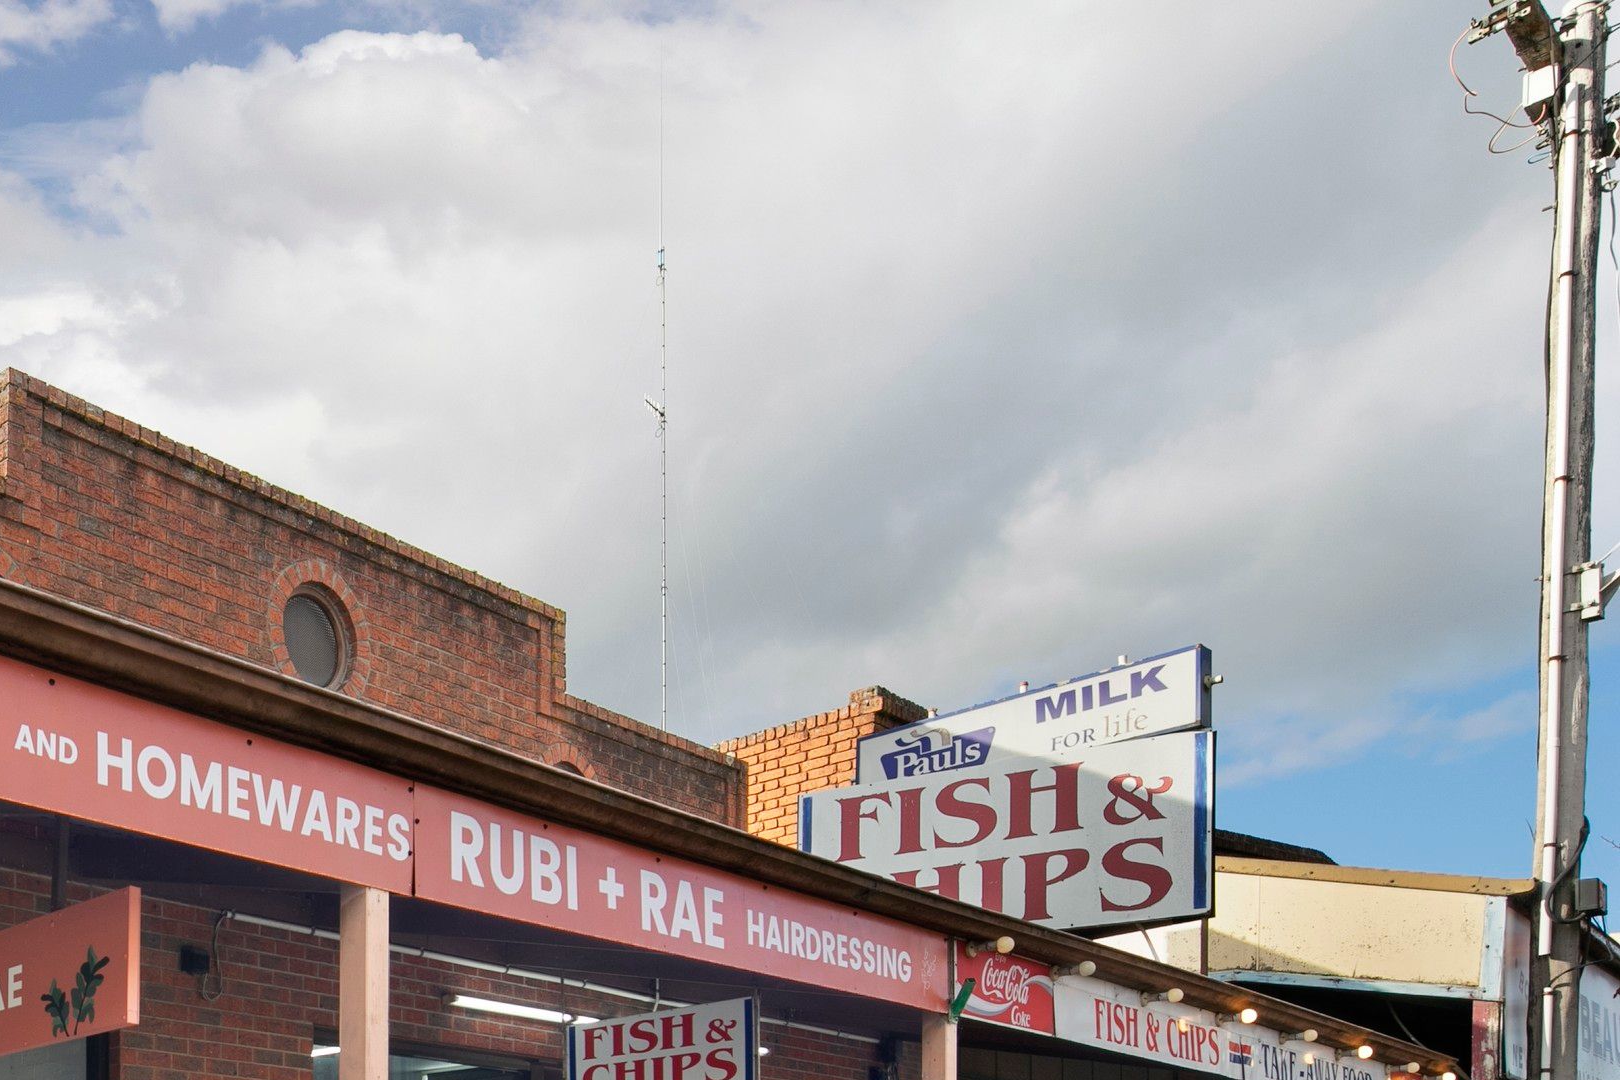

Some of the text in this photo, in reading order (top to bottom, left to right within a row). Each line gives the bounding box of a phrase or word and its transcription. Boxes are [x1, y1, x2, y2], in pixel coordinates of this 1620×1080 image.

[1035, 663, 1168, 725] MILK
[893, 738, 981, 778] Pauls
[1052, 707, 1149, 752] FOR life
[13, 722, 79, 766] AND
[96, 730, 411, 862] HOMEWARES
[835, 760, 1174, 863] FISH &
[450, 809, 913, 984] RUBI + RAE HAIRDRESSING
[888, 836, 1174, 922] HIPS
[981, 957, 1030, 1005] Coca-Cola
[582, 1012, 738, 1061] FISH &
[1011, 1005, 1031, 1028] Coke
[1094, 998, 1220, 1067] FISH & CHIPS
